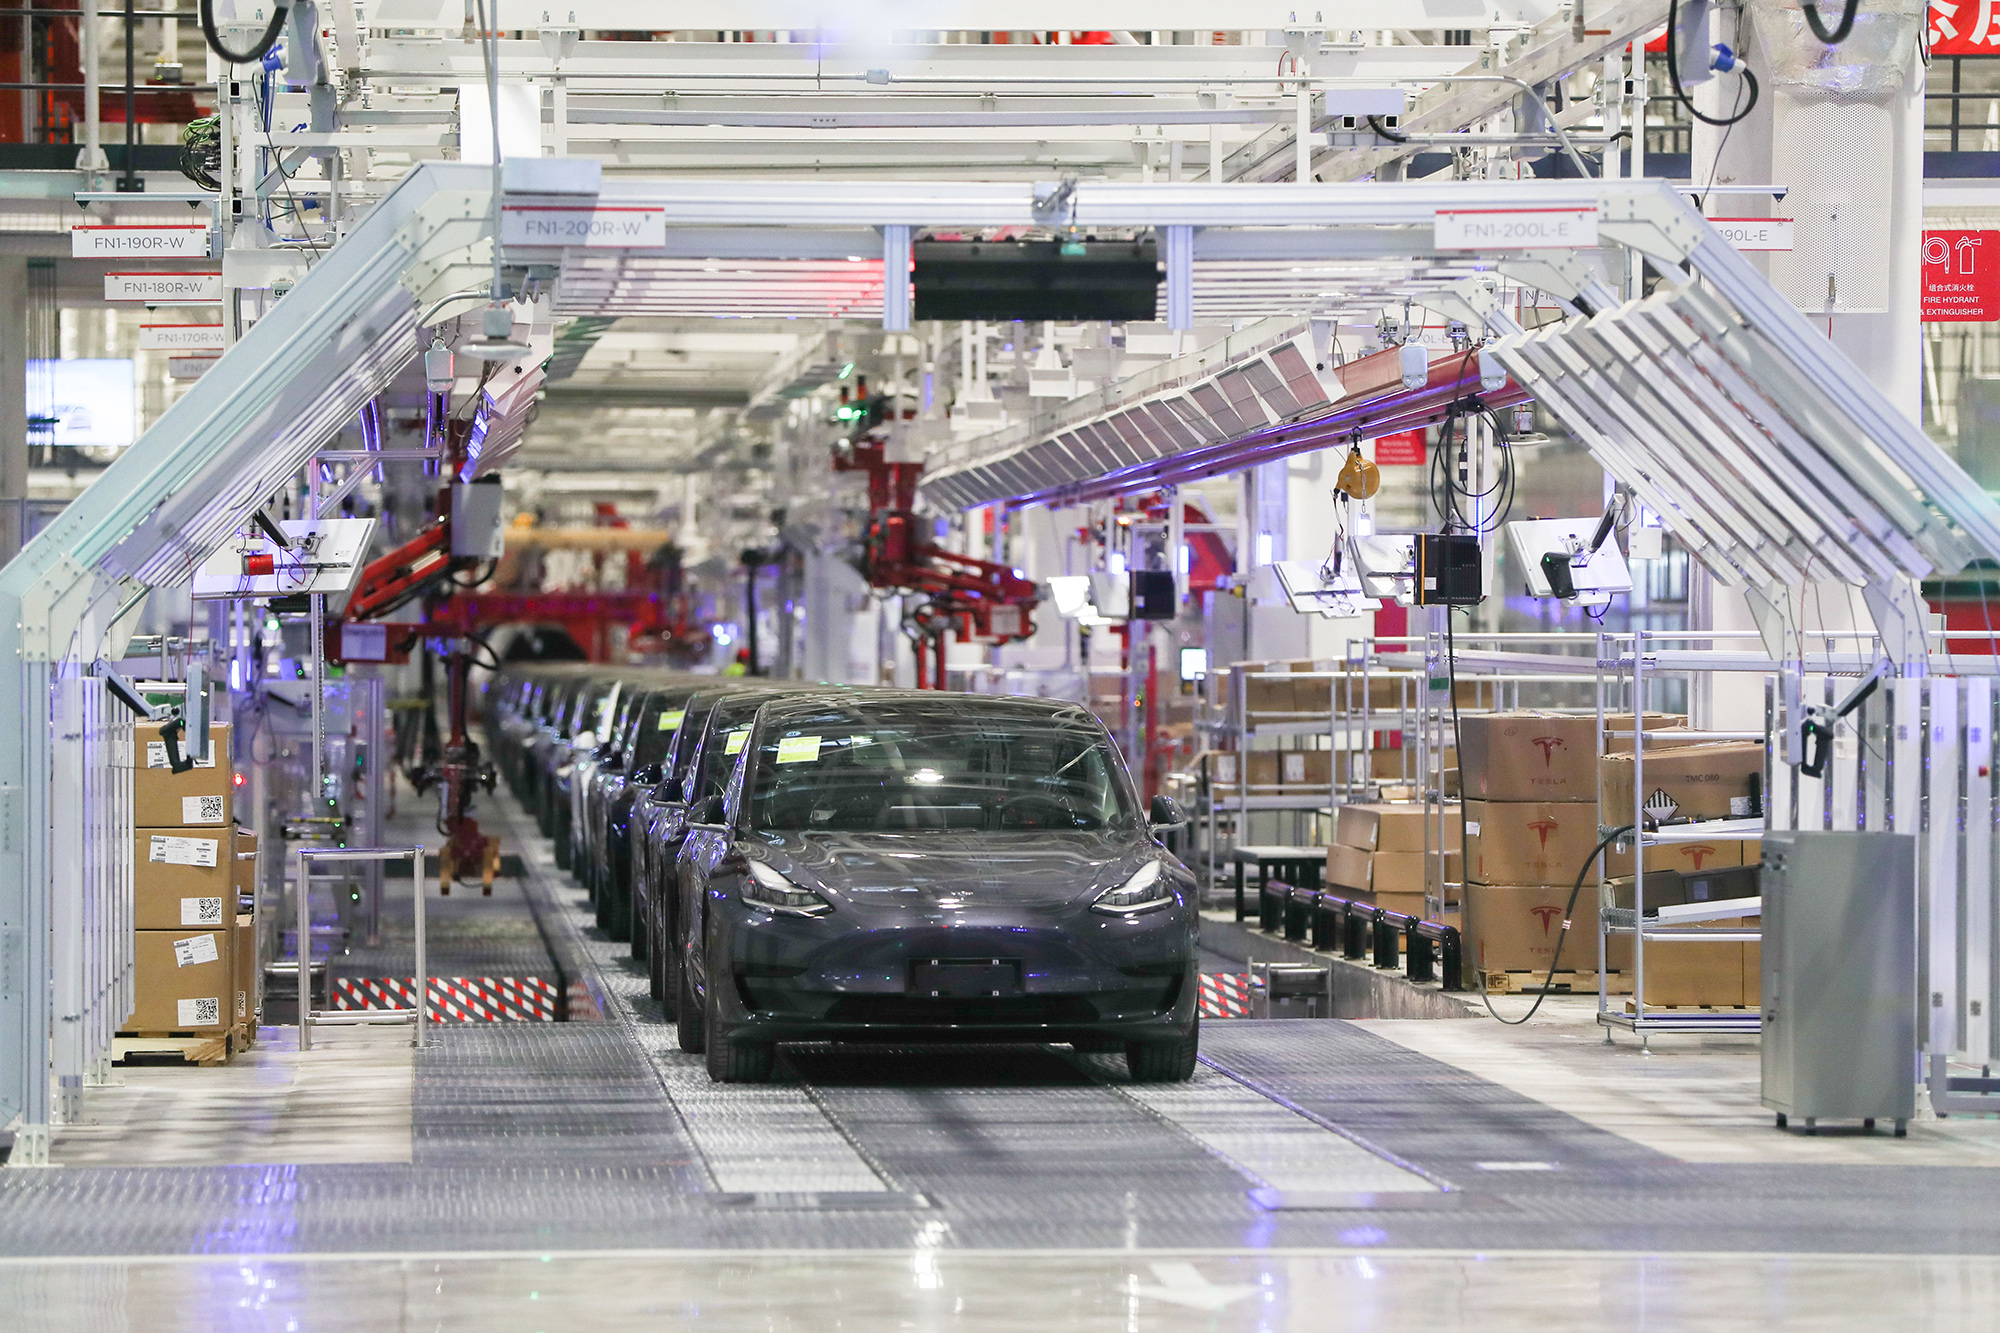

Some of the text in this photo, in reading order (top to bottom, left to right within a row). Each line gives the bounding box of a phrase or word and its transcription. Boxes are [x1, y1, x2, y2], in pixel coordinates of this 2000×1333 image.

[525, 220, 641, 235] FN1-200R-W
[1464, 222, 1569, 238] FN1-200L-E
[94, 237, 185, 248] FN1-190R-W
[124, 282, 203, 293] FN1-180R-W
[157, 333, 224, 343] FN1-170R-W
[1685, 773, 1720, 783] TMC 080
